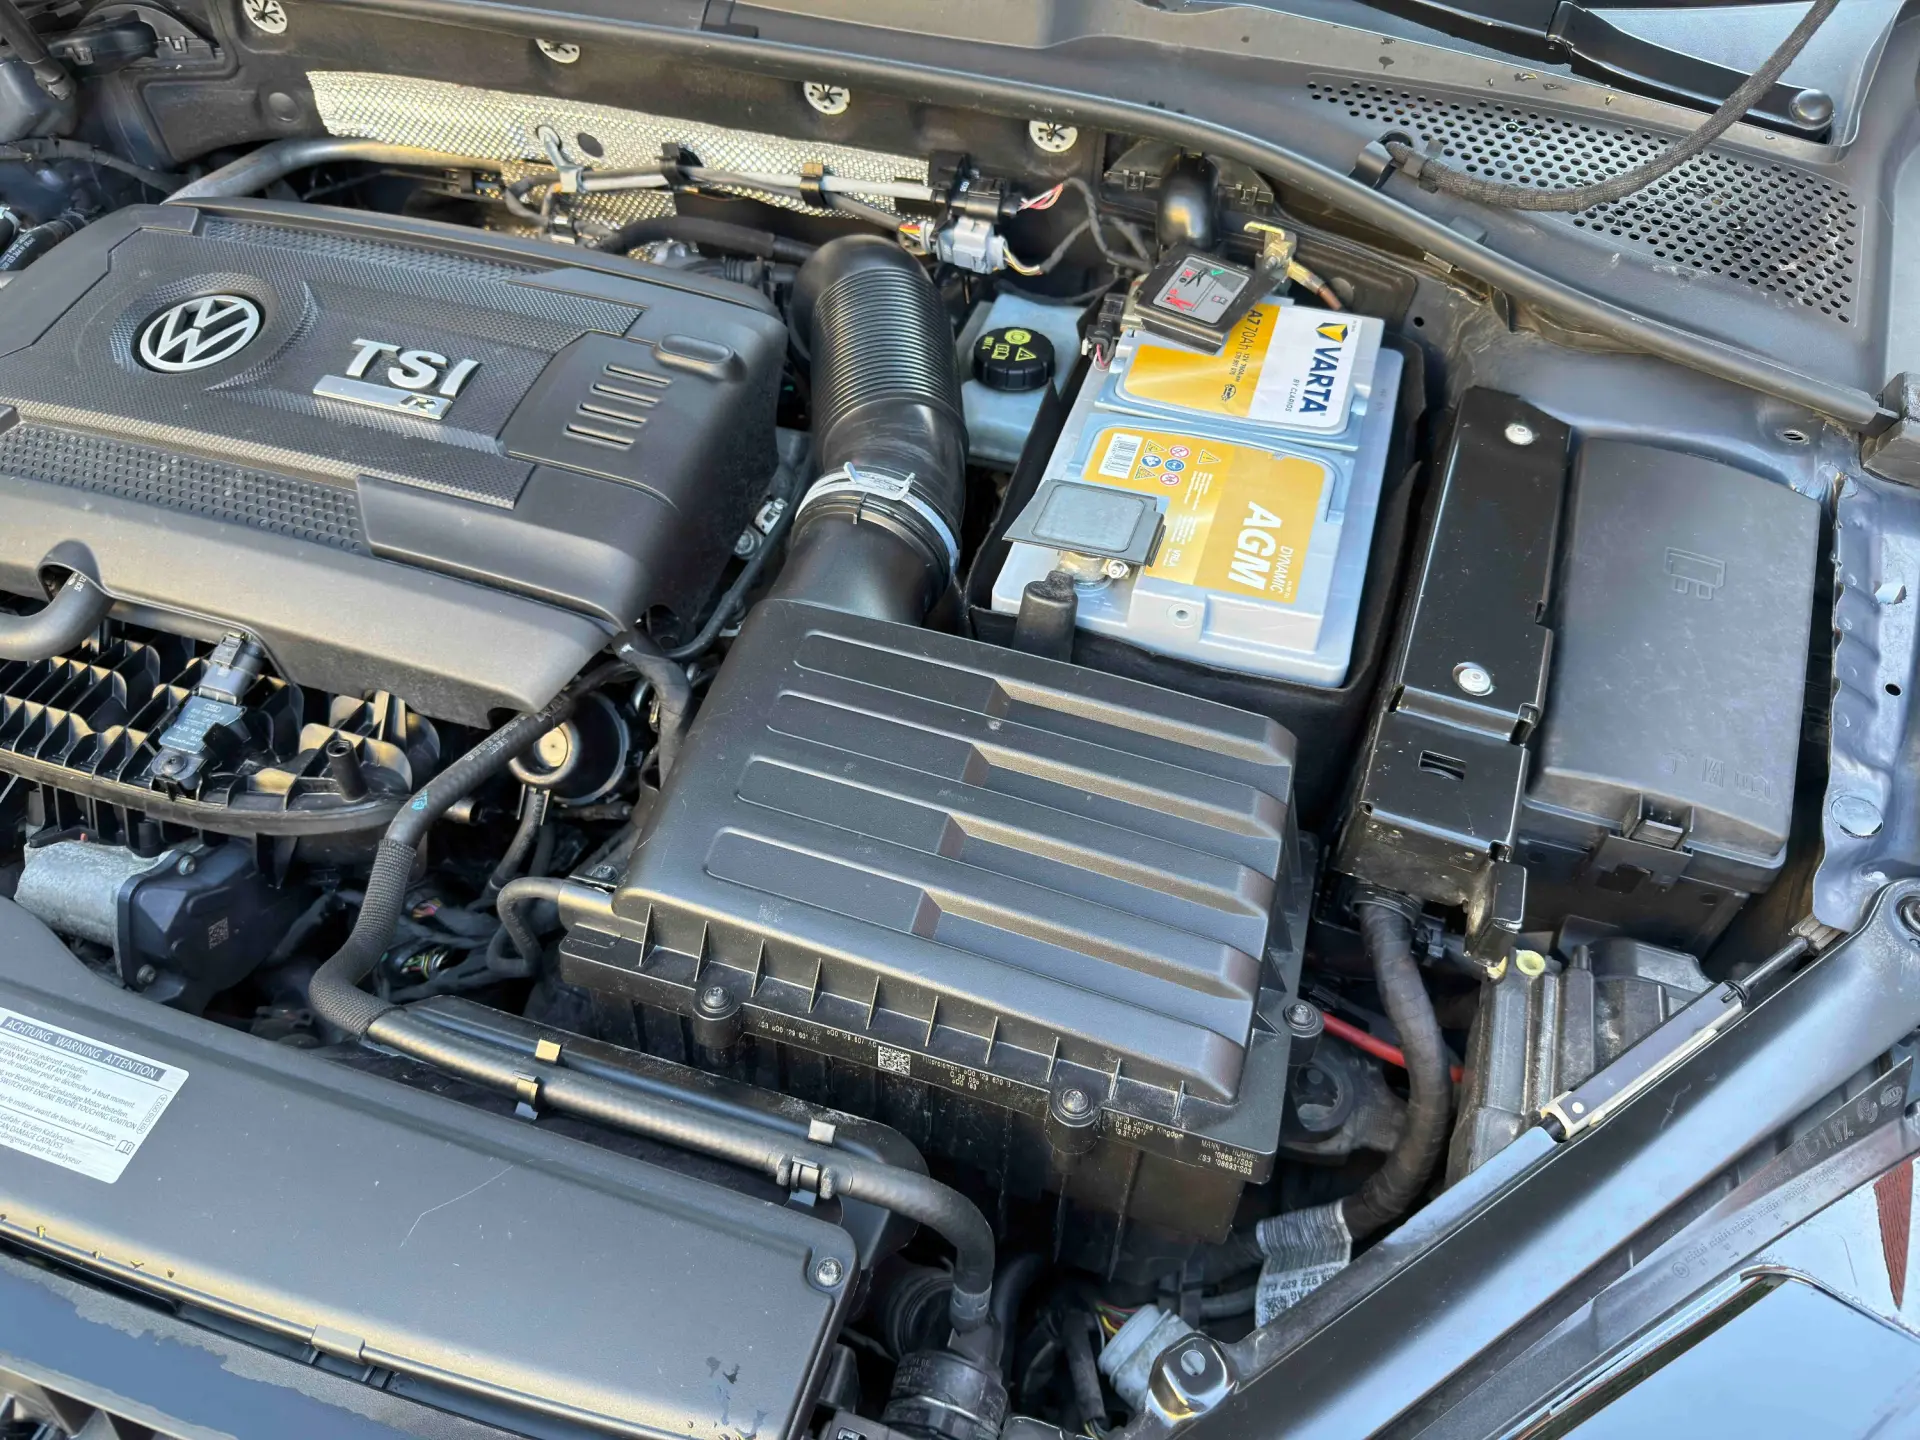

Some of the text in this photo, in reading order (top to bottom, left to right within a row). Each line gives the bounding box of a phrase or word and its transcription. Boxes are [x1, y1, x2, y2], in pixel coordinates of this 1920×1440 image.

[1240, 308, 1264, 352] A7 70Ah
[345, 338, 478, 396] TSI
[1298, 347, 1342, 415] VARTA
[1285, 378, 1300, 413] BY CLARIOS
[1227, 501, 1283, 590] AGM
[1269, 546, 1294, 595] DYNAMIC
[6, 1020, 158, 1078] ACHTUNG WARNING ATTENTION
[1133, 1120, 1154, 1132] United
[1156, 1126, 1184, 1140] Kingdom
[1201, 1140, 1220, 1151] MANN
